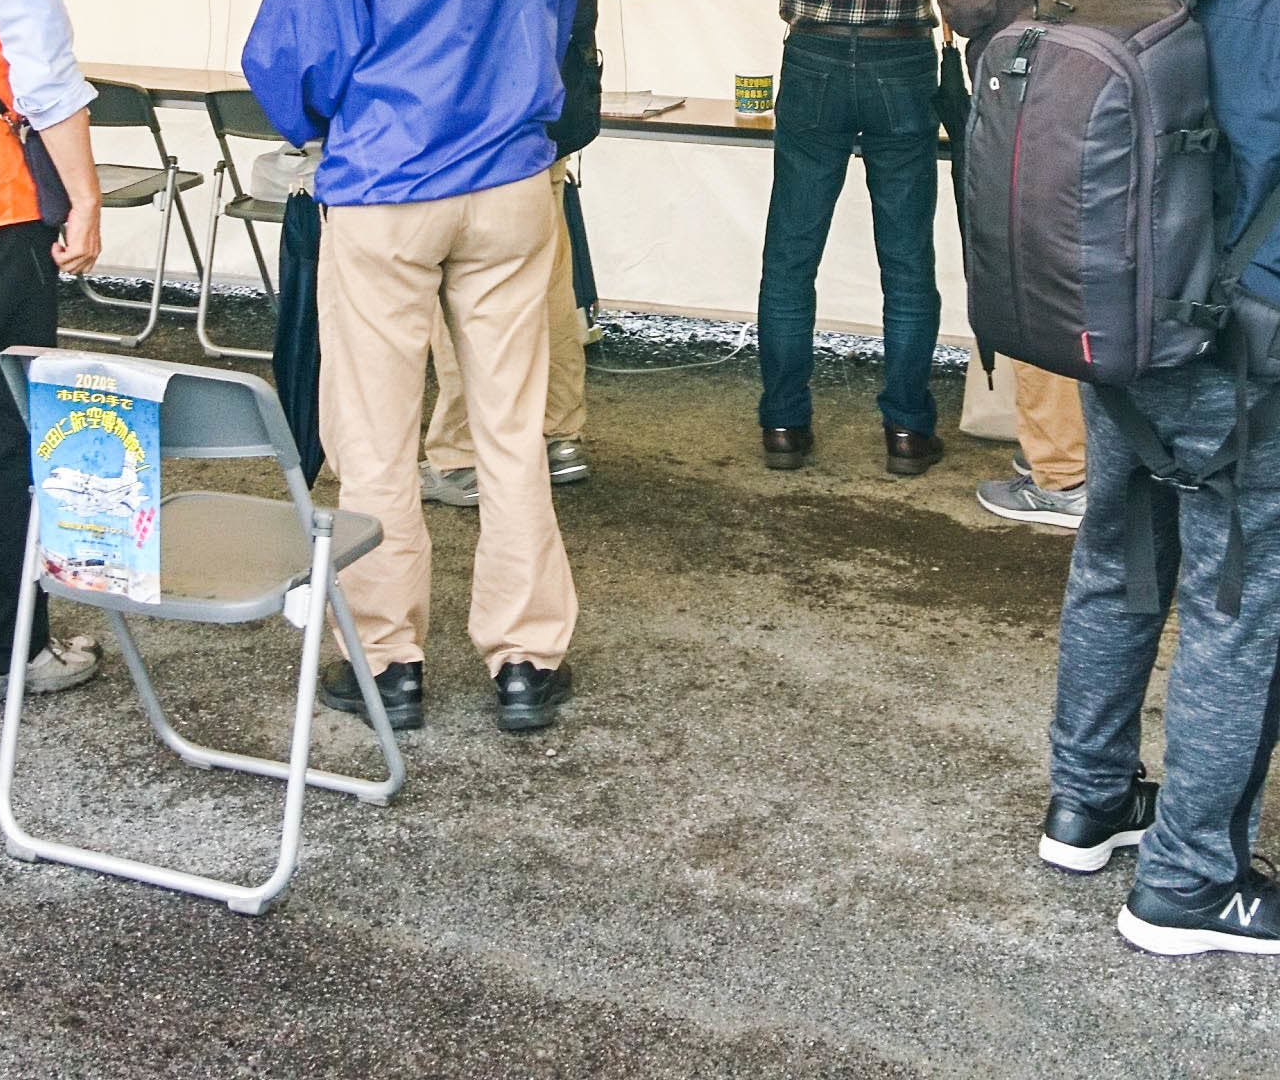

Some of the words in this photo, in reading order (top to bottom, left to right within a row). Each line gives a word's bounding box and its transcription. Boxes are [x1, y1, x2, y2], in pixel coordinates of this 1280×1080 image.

[75, 373, 118, 392] 2020年
[56, 389, 134, 410] 市民の手で
